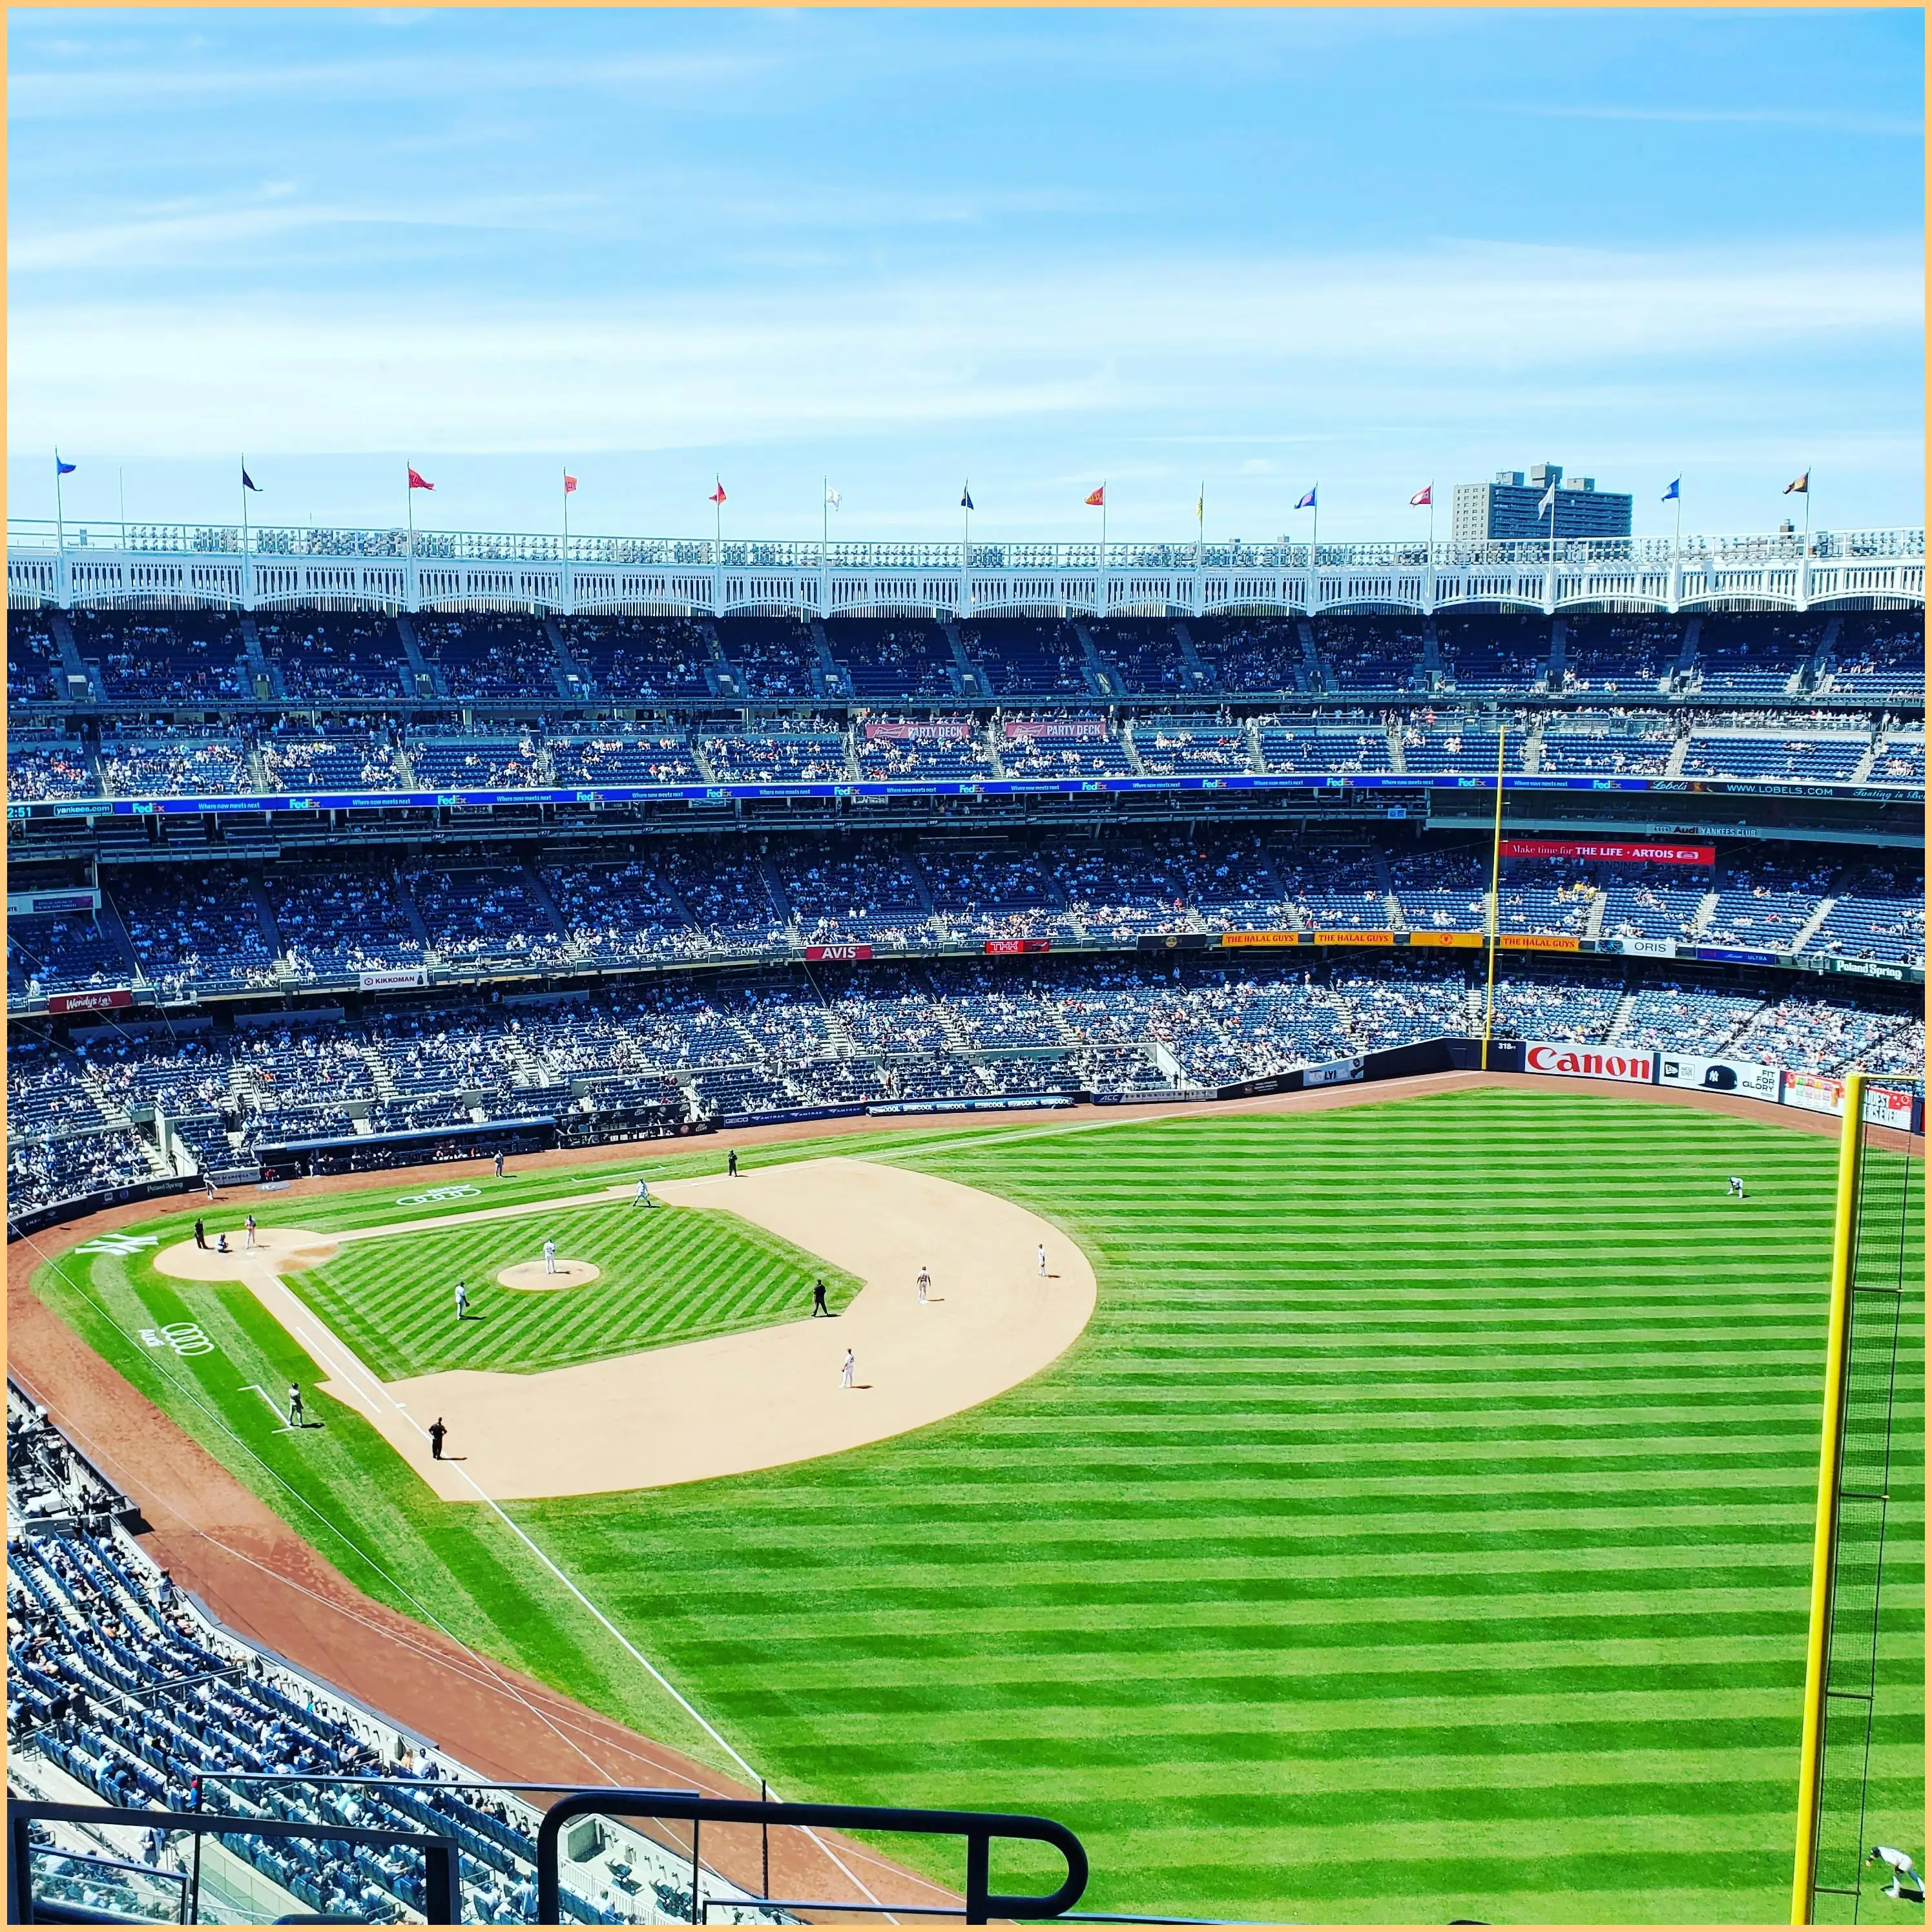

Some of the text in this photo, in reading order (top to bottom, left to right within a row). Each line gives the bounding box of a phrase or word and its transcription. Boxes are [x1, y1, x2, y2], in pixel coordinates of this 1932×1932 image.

[908, 727, 937, 737] PARTY
[938, 727, 962, 738] DECK
[1046, 725, 1077, 736] PARTY
[1077, 725, 1100, 736] DECK
[1082, 782, 1107, 791] FedEx
[1202, 779, 1227, 788] FedEx
[1327, 777, 1353, 786] FedEx
[1458, 778, 1486, 787] FedEx
[1593, 780, 1621, 789] FedEx
[707, 789, 732, 798] FedEx
[834, 786, 860, 795] FedEx
[959, 784, 985, 793] FedEx
[1727, 784, 1833, 796] WWW.LOBELS.COM
[437, 795, 466, 805] FedEx
[577, 792, 604, 801] FedEx
[132, 803, 165, 813] FedEx
[289, 798, 320, 809] FedEx
[57, 805, 110, 815] yankees.com
[1513, 845, 1674, 858] Make time for THE LIFE ARTOIS
[990, 940, 1019, 950] THK
[1634, 942, 1666, 952] ORIS
[822, 947, 857, 959] AVIS
[1836, 960, 1902, 980] Poland Spring
[67, 996, 98, 1010] Wendy's
[1528, 1046, 1650, 1080] Canon
[1762, 1070, 1775, 1078] FIT
[1756, 1076, 1775, 1085] FOR
[1742, 1081, 1774, 1092] GLORY
